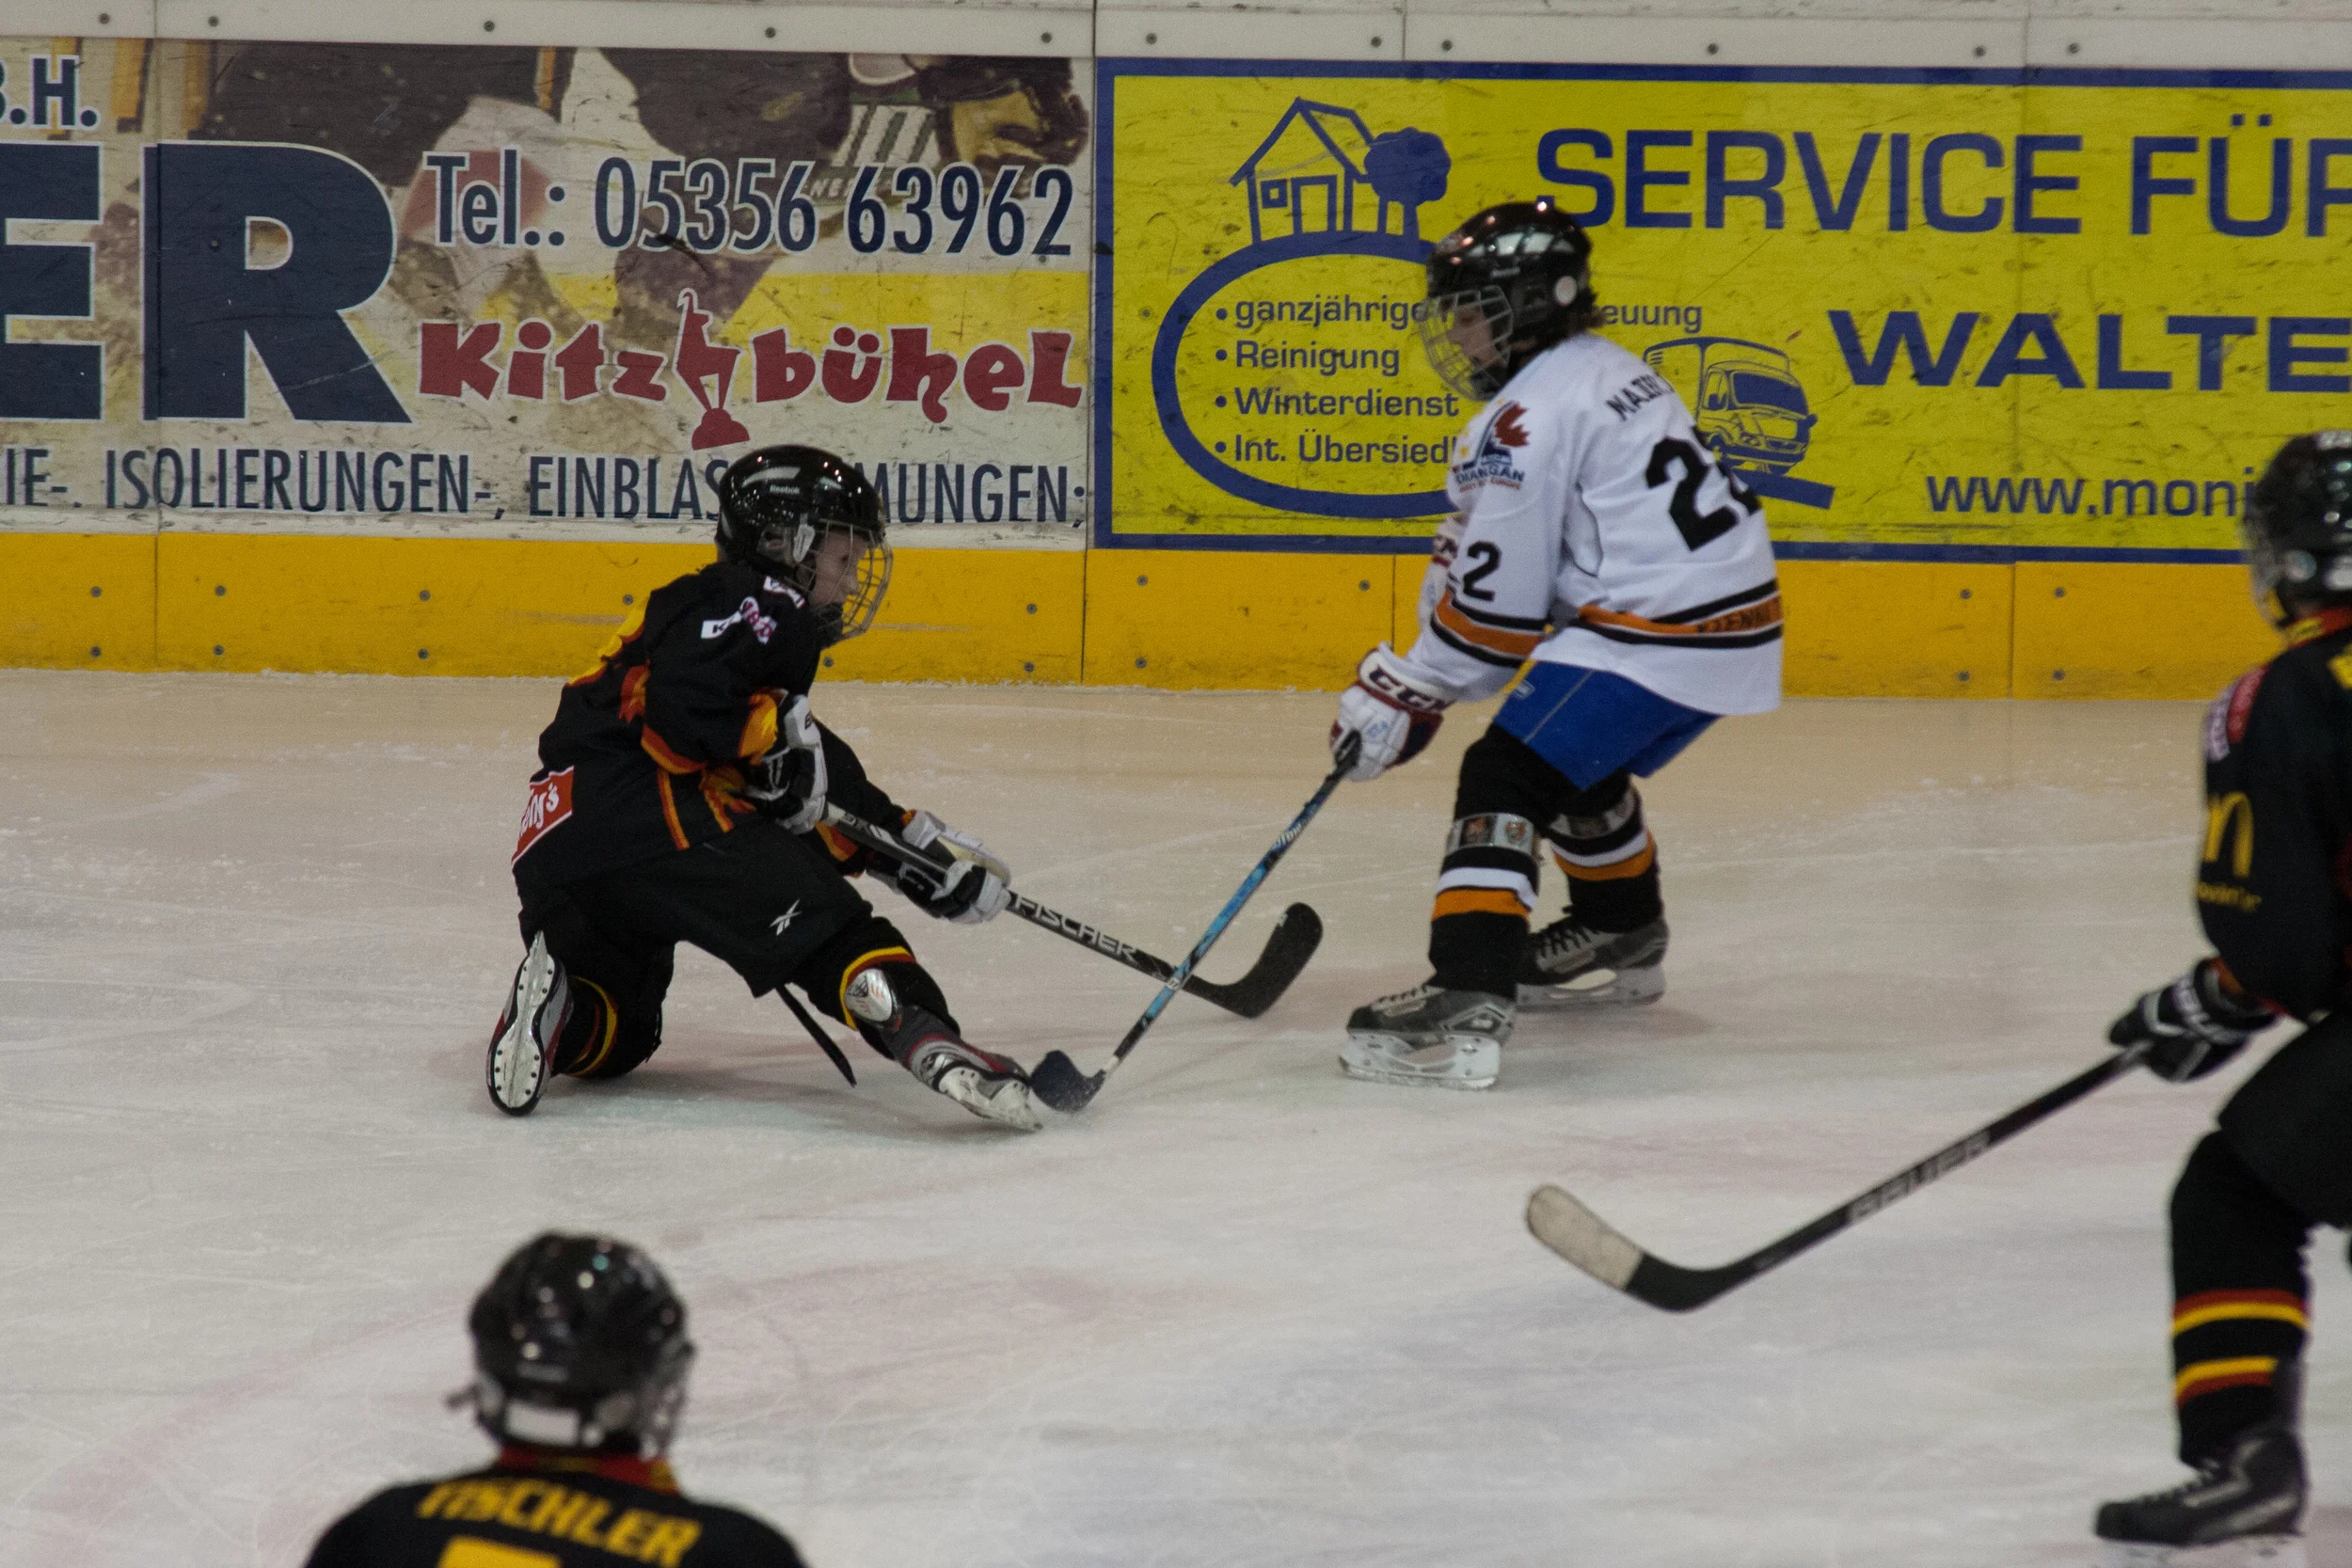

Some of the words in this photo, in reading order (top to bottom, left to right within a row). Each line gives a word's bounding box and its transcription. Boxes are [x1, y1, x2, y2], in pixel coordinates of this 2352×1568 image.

[0, 58, 97, 126] .H.
[595, 157, 816, 252] 05356
[848, 166, 1072, 256] 63962
[1537, 128, 2082, 234] SERVICE
[1235, 294, 1444, 329] ganzjährige
[1597, 304, 1702, 334] euung
[1236, 340, 1400, 376] Reinigung
[1234, 387, 1460, 416] Winterdienst
[1235, 434, 1287, 462] Int.
[1015, 896, 1139, 966] FISCHER
